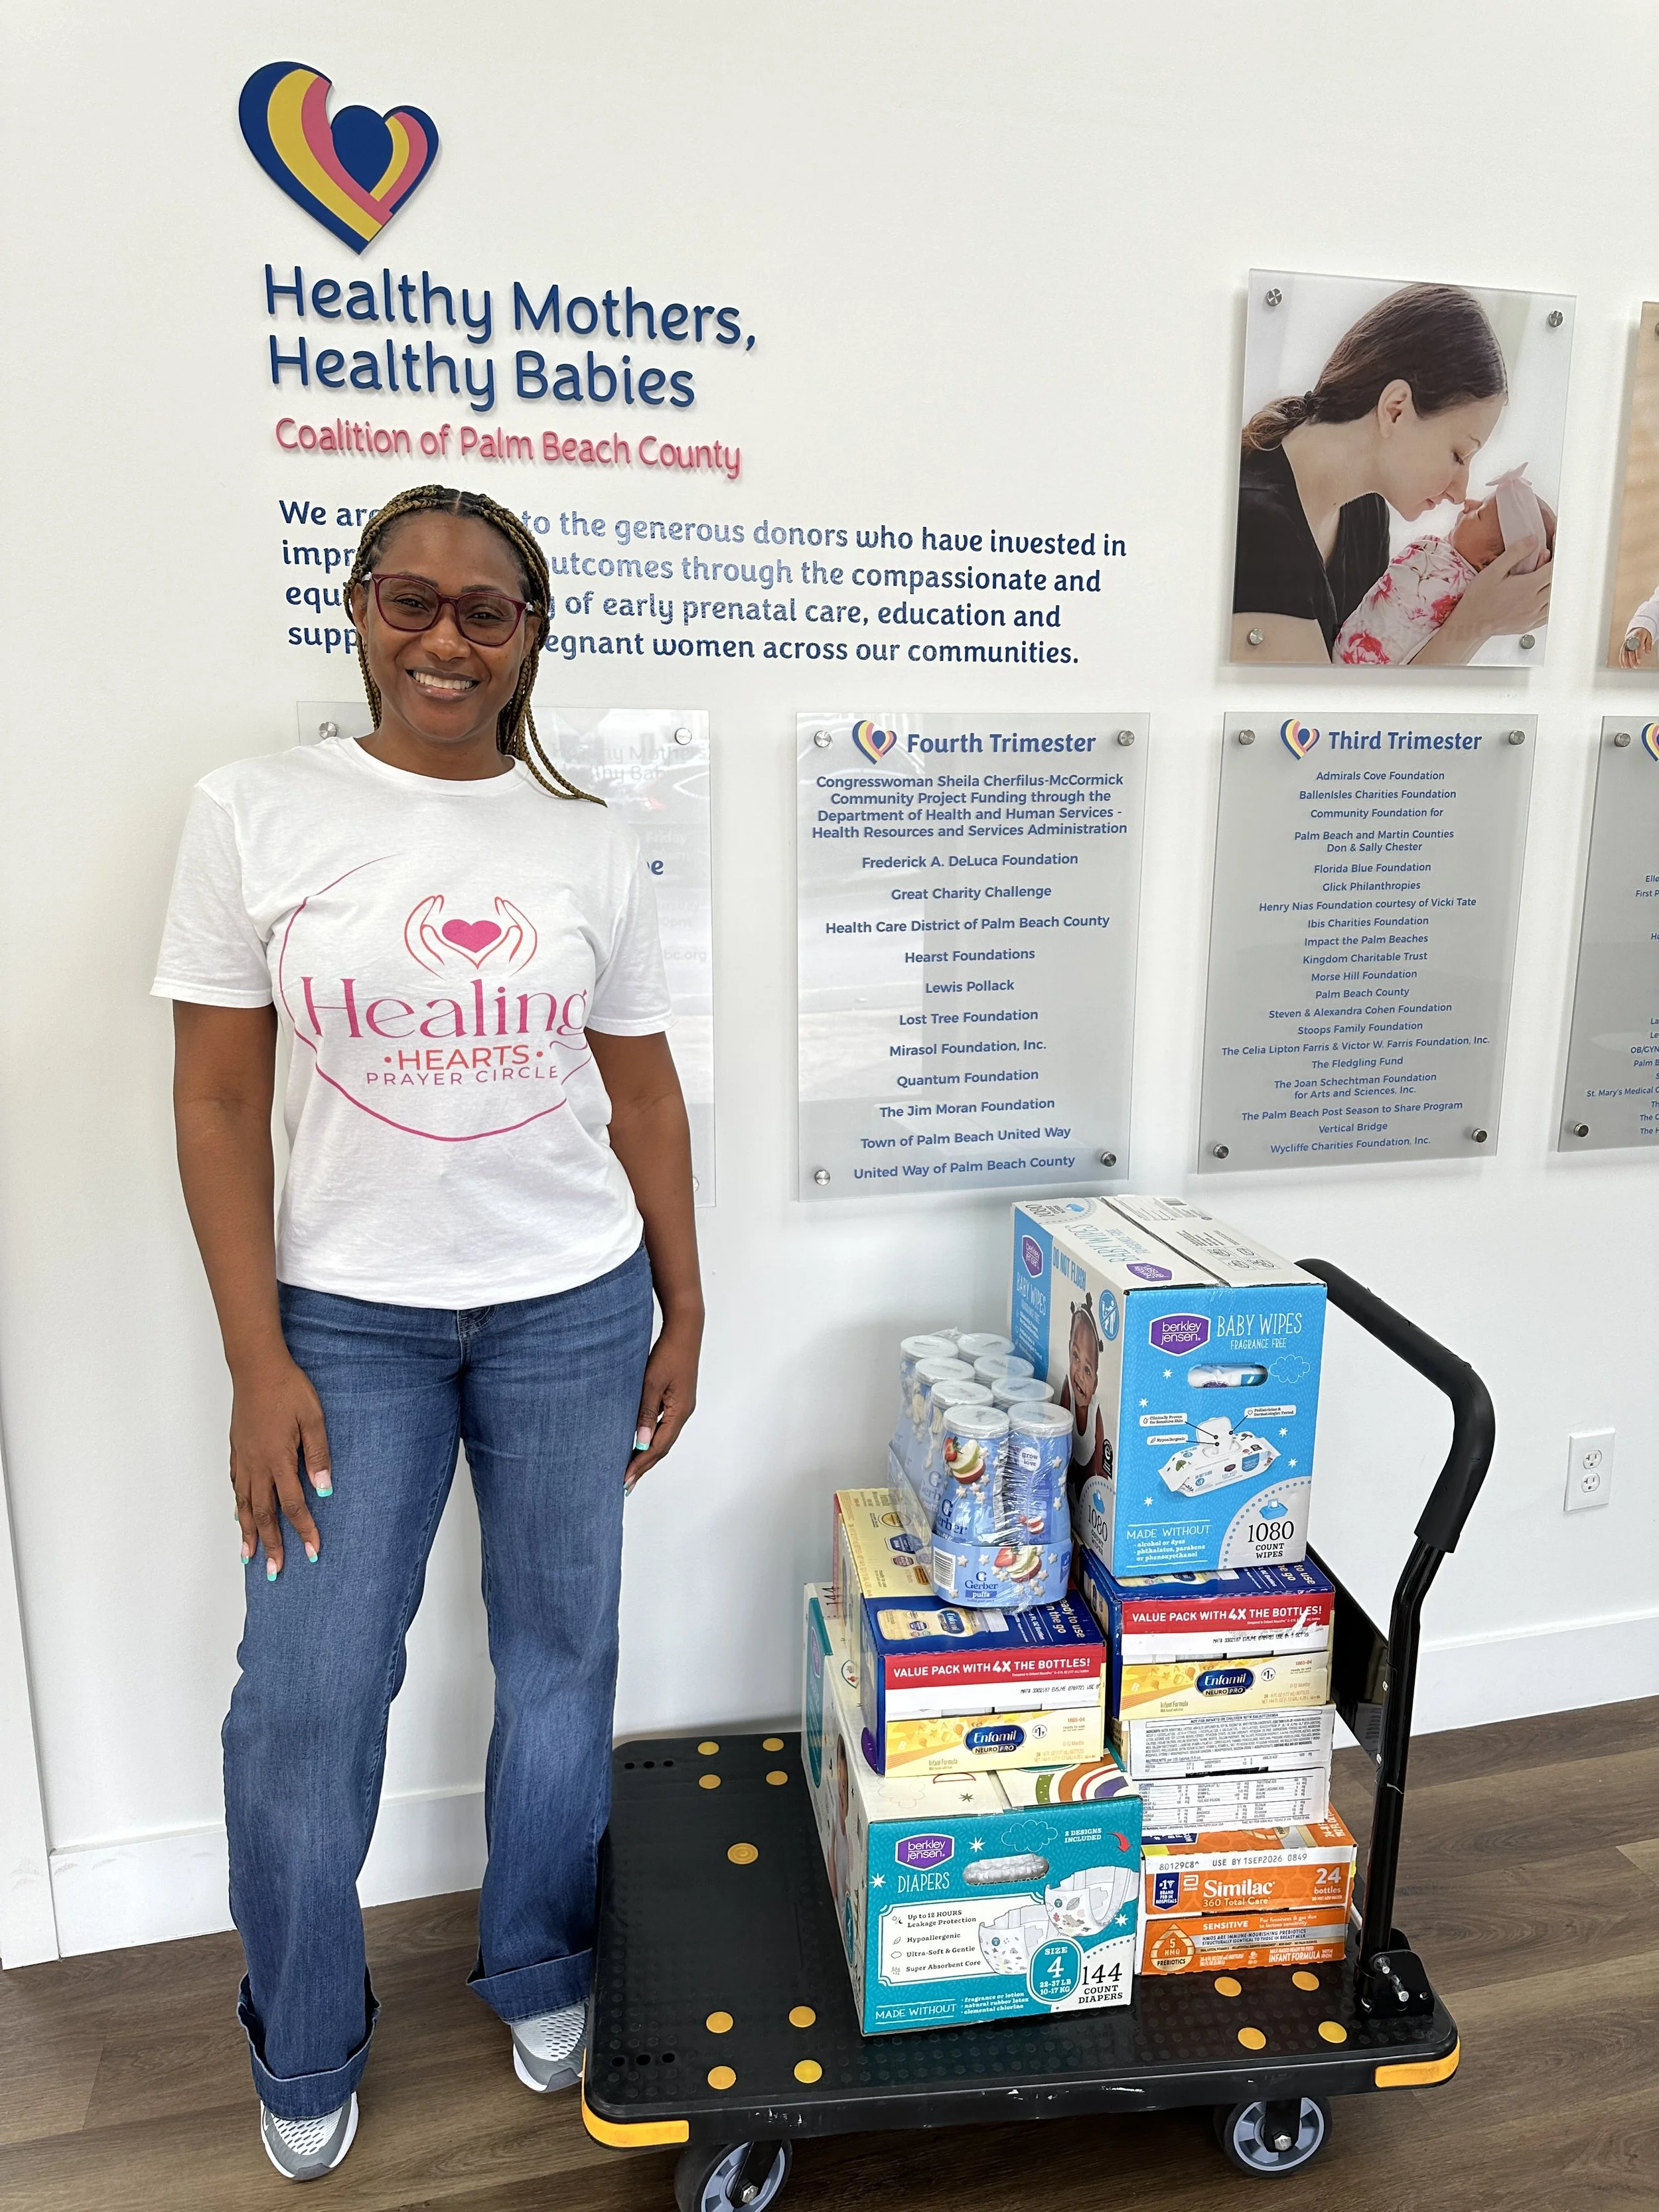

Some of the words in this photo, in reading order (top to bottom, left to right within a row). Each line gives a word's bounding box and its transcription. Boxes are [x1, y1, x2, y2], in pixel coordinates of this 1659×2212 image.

[265, 263, 492, 344] Healthy
[513, 281, 755, 351] Mothers,
[269, 334, 495, 412] Healthy
[516, 350, 695, 408] Babies
[275, 417, 411, 455] Coalition
[420, 423, 451, 455] of
[460, 426, 534, 461] Palm
[542, 431, 631, 465] Beach
[638, 435, 740, 480] County
[279, 500, 326, 526] We
[522, 510, 550, 534] to
[559, 510, 606, 537] the
[614, 520, 745, 546] generous
[753, 520, 848, 548] donors
[856, 524, 913, 550] who
[922, 526, 983, 552] have
[991, 529, 1096, 556] invested
[1104, 533, 1127, 557] in
[545, 552, 673, 579] utcomes
[681, 555, 794, 590] through
[801, 560, 844, 585] the
[851, 565, 1046, 595] compassionate
[1054, 569, 1101, 592] and
[565, 590, 595, 615] of
[603, 593, 674, 625] early
[682, 597, 797, 626] prenatal
[805, 605, 869, 626] care,
[878, 601, 1006, 627] education
[1013, 605, 1061, 628] and
[288, 626, 357, 654] supp
[545, 632, 644, 660] egnant
[653, 638, 755, 658] women
[763, 641, 848, 660] across
[856, 644, 901, 661] our
[908, 640, 1078, 664] communities.
[907, 732, 983, 753] Fourth
[989, 732, 1097, 753] Trimester
[1329, 730, 1382, 750] Third
[1388, 731, 1482, 750] Trimester
[816, 776, 933, 790] Congresswoman
[937, 774, 979, 787] Sheila
[983, 773, 1123, 786] Cherfilus-McCormick
[1316, 771, 1361, 780] Admirals
[1363, 771, 1387, 780] Cove
[1389, 771, 1445, 780] Foundation
[1299, 790, 1352, 800] BallenIsles
[1355, 790, 1398, 799] Charities
[1401, 789, 1457, 798] Foundation
[862, 855, 927, 869] Frederick
[930, 855, 944, 867] A.
[949, 855, 998, 867] DeLuca
[1002, 853, 1078, 865] Foundation
[1314, 864, 1348, 873] Florida
[1351, 863, 1373, 873] Blue
[1376, 862, 1431, 872] Foundation
[891, 889, 929, 901] Great
[932, 887, 981, 901] Charity
[985, 885, 1052, 899] Challenge
[1323, 882, 1347, 892] Glick
[1350, 881, 1421, 891] Philanthropies
[905, 951, 949, 963] Hearst
[953, 948, 1035, 962] Foundations
[1303, 954, 1348, 966] Kingdom
[1350, 952, 1401, 962] Charitable
[1404, 952, 1428, 960] Trust
[1311, 973, 1340, 982] Morse
[1343, 971, 1360, 980] Hill
[1362, 970, 1417, 980] Foundation
[926, 981, 963, 994] Lewis
[967, 979, 1015, 992] Pollack
[301, 977, 588, 1051] Healing
[900, 1014, 928, 1025] Lost
[930, 1013, 960, 1024] Tree
[964, 1009, 1039, 1023] Foundation
[890, 1043, 937, 1057] Mirasol
[942, 1041, 1020, 1054] Foundation,
[1024, 1040, 1046, 1051] Inc.
[398, 1045, 530, 1070] HEARTS
[1311, 1060, 1329, 1069] The
[1332, 1058, 1376, 1069] Fledgling
[1379, 1056, 1404, 1066] Fund
[366, 1072, 463, 1086] PRAYER
[476, 1065, 558, 1083] CIRCLE
[897, 1074, 960, 1088] Quantum
[964, 1070, 1039, 1083] Foundation
[1624, 1086, 1654, 1095] Medical
[879, 1106, 904, 1118] The
[907, 1104, 932, 1116] Jim
[936, 1104, 977, 1115] Moran
[981, 1098, 1055, 1112] Foundation
[1319, 1123, 1354, 1134] Vertical
[1357, 1122, 1388, 1132] Bridge
[1270, 1143, 1309, 1155] Wycliffe
[1311, 1142, 1354, 1151] Charities
[1414, 1136, 1431, 1145] Inc.
[854, 1165, 898, 1179] United
[902, 1165, 930, 1177] Way
[933, 1163, 947, 1174] of
[950, 1161, 983, 1173] Palm
[987, 1157, 1026, 1171] Beach
[1030, 1156, 1076, 1168] County
[1162, 1320, 1202, 1335] berkley
[1216, 1314, 1256, 1337] BABY
[1259, 1312, 1303, 1335] WIPES
[1230, 1338, 1269, 1350] FRAGRANCE
[1271, 1337, 1287, 1349] FREE
[1127, 1529, 1157, 1540] MADE
[1162, 1524, 1211, 1537] WITHOUT
[1248, 1520, 1295, 1543] 1080
[1255, 1542, 1285, 1552] COUNT
[1256, 1550, 1283, 1559] WIPES
[964, 1580, 999, 1589] Gerber
[893, 1666, 929, 1678] VALUE
[931, 1664, 960, 1675] PACK
[962, 1662, 991, 1673] WITH
[992, 1660, 1011, 1673] 4X
[1013, 1660, 1036, 1670] THE
[1038, 1657, 1090, 1669] BOTTLES!
[1204, 1673, 1246, 1686] Enfamil
[974, 1730, 1017, 1743] Enfamil
[908, 1839, 946, 1851] berkley
[1212, 1858, 1227, 1867] USE
[1243, 1855, 1283, 1864] 1SEP2026
[1287, 1853, 1307, 1862] 0849
[897, 1872, 950, 1893] DIAPERS
[1315, 1867, 1341, 1884] 24
[1203, 1878, 1273, 1898] Similac
[1313, 1885, 1340, 1895] bottles
[1202, 1898, 1222, 1907] 360
[1224, 1897, 1245, 1906] Total
[1202, 1920, 1249, 1931] SENSITIVE
[906, 1933, 961, 1944] Hypoallergenic
[1045, 1947, 1068, 1955] SIZE
[927, 1962, 964, 1970] Absorbent
[1046, 1956, 1064, 1978] 4
[1083, 1962, 1123, 1985] 144
[1078, 1992, 1123, 2004] DIAPERS
[1084, 1985, 1119, 1995] COUNT
[875, 2008, 905, 2020] MADE
[908, 2004, 957, 2016] WITHOUT
